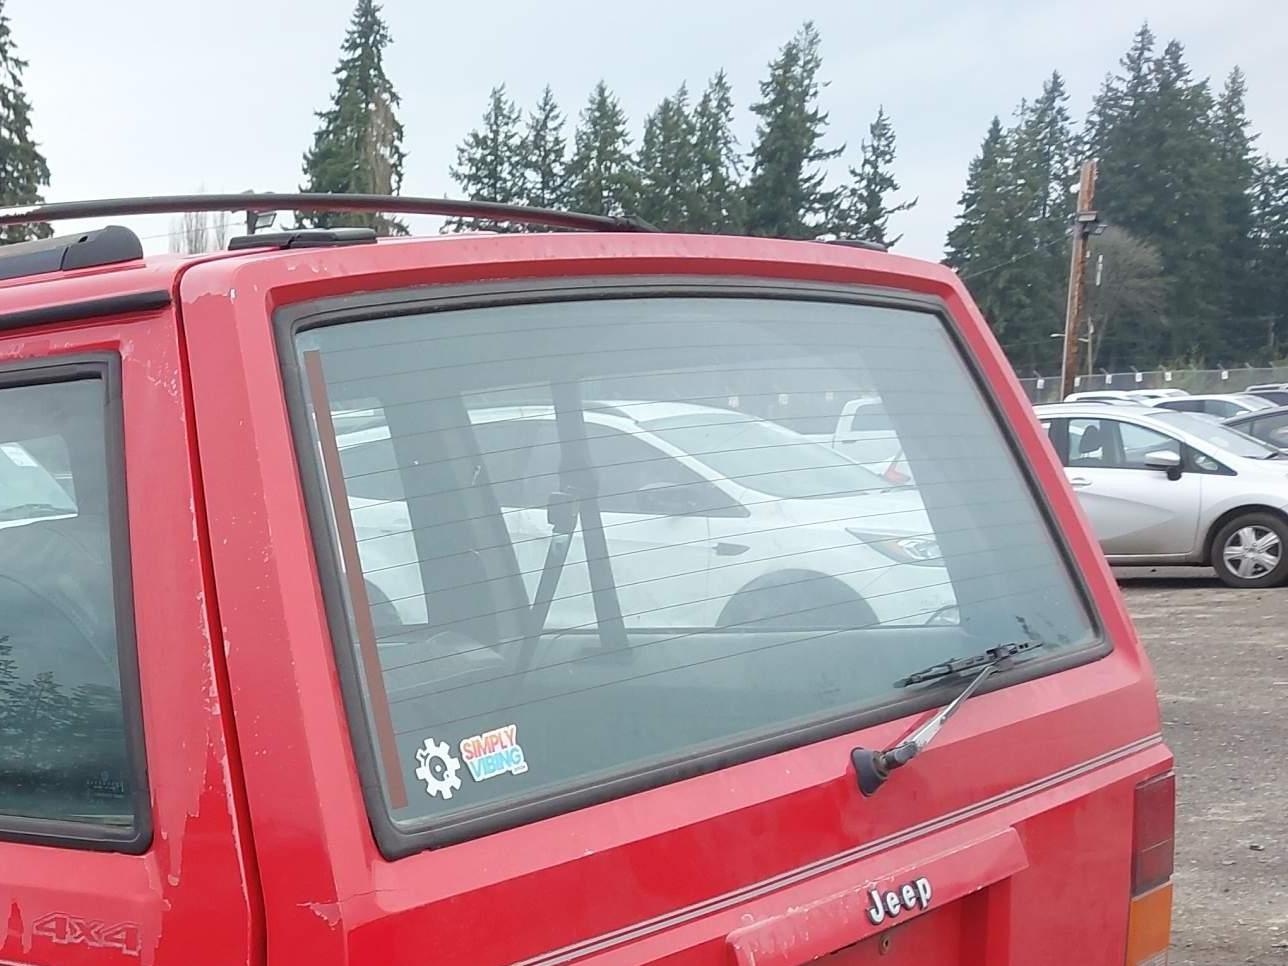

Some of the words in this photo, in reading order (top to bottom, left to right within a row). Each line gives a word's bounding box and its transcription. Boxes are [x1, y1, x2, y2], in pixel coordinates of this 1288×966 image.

[463, 728, 514, 760] SIMPLY
[470, 747, 522, 778] VIBING
[868, 877, 933, 924] Jeep
